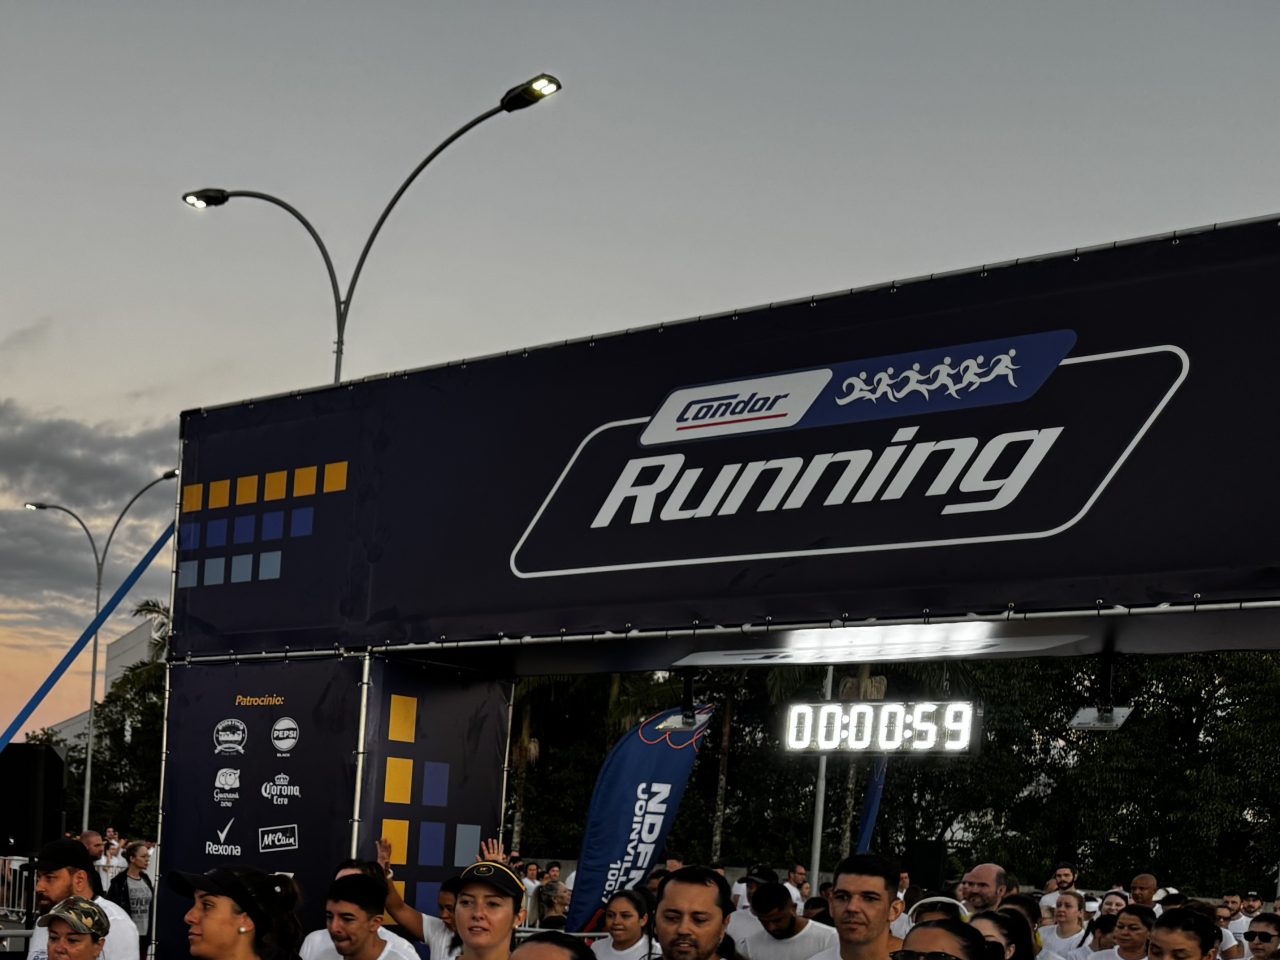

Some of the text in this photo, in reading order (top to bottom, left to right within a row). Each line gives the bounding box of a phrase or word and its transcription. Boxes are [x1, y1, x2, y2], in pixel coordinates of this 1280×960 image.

[676, 391, 790, 423] Condor
[590, 425, 1065, 529] Running
[235, 693, 285, 706] Patrocínio:
[273, 730, 297, 738] PEPSI
[788, 703, 972, 750] 00:00:59
[261, 782, 302, 799] Corona
[261, 831, 296, 848] McCain
[614, 782, 649, 891] JOINVILL
[205, 841, 241, 856] Rexona
